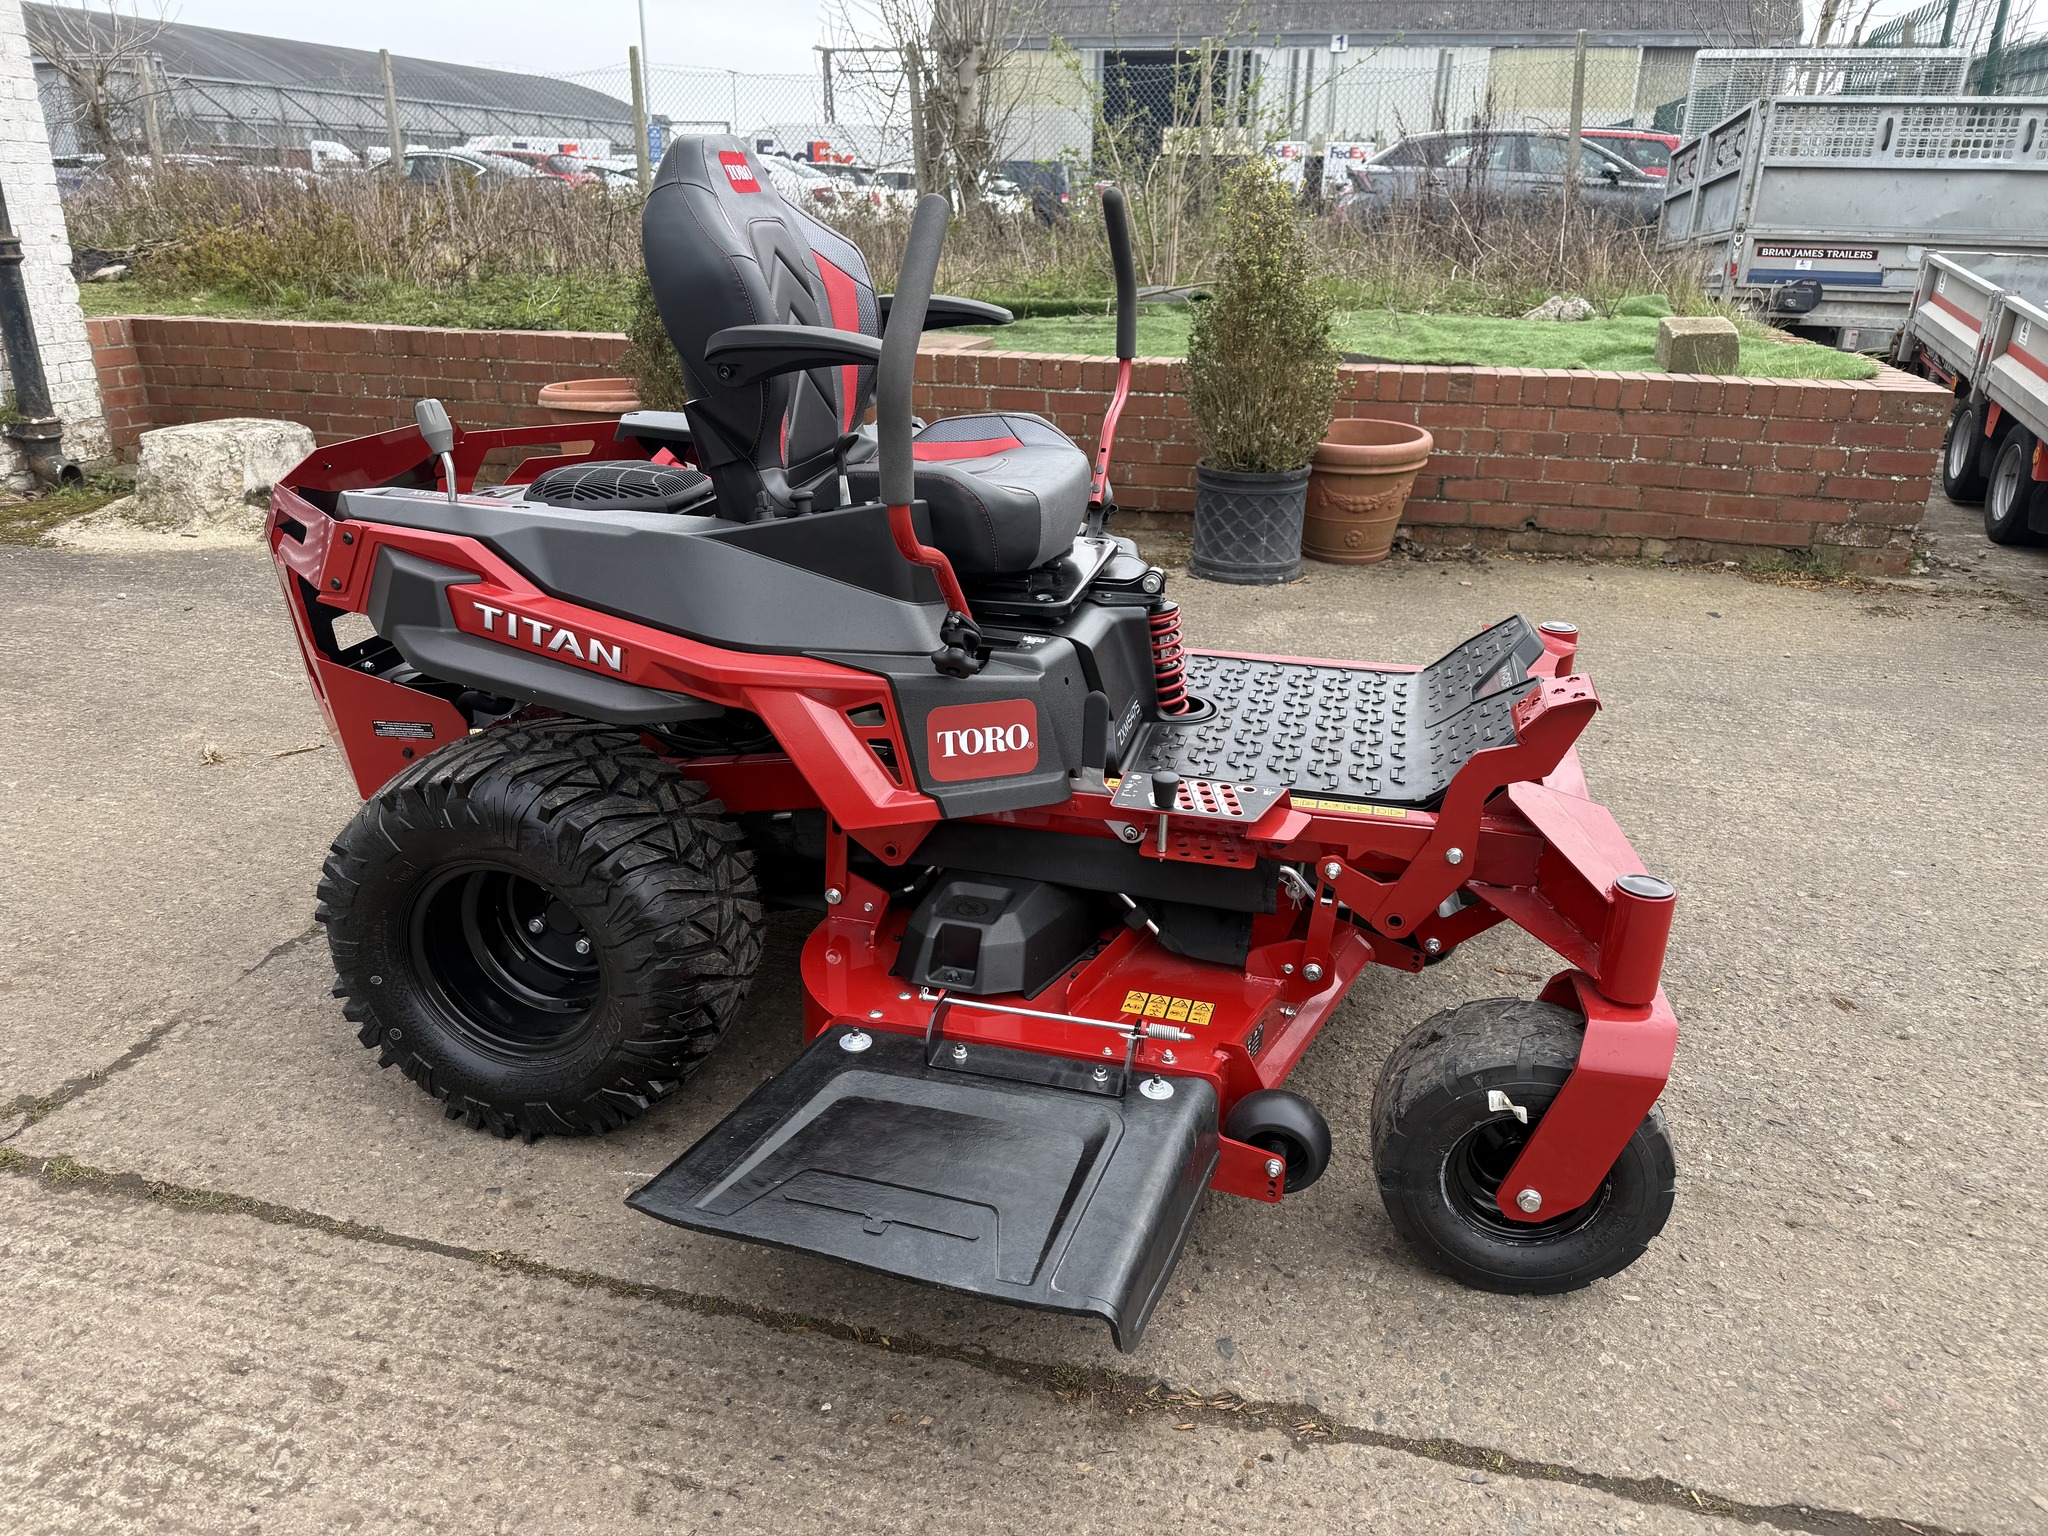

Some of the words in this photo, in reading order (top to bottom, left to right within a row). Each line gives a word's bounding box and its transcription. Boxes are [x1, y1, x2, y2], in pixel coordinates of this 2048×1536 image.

[1336, 35, 1344, 50] 1
[1266, 145, 1298, 158] edEx
[1330, 146, 1367, 160] FedEx
[724, 164, 753, 180] TORO
[1761, 248, 1792, 257] BRIAN
[1792, 248, 1824, 258] JAMES
[1827, 250, 1873, 260] TRAILERS
[472, 601, 622, 672] TITAN
[936, 723, 1030, 758] TORO
